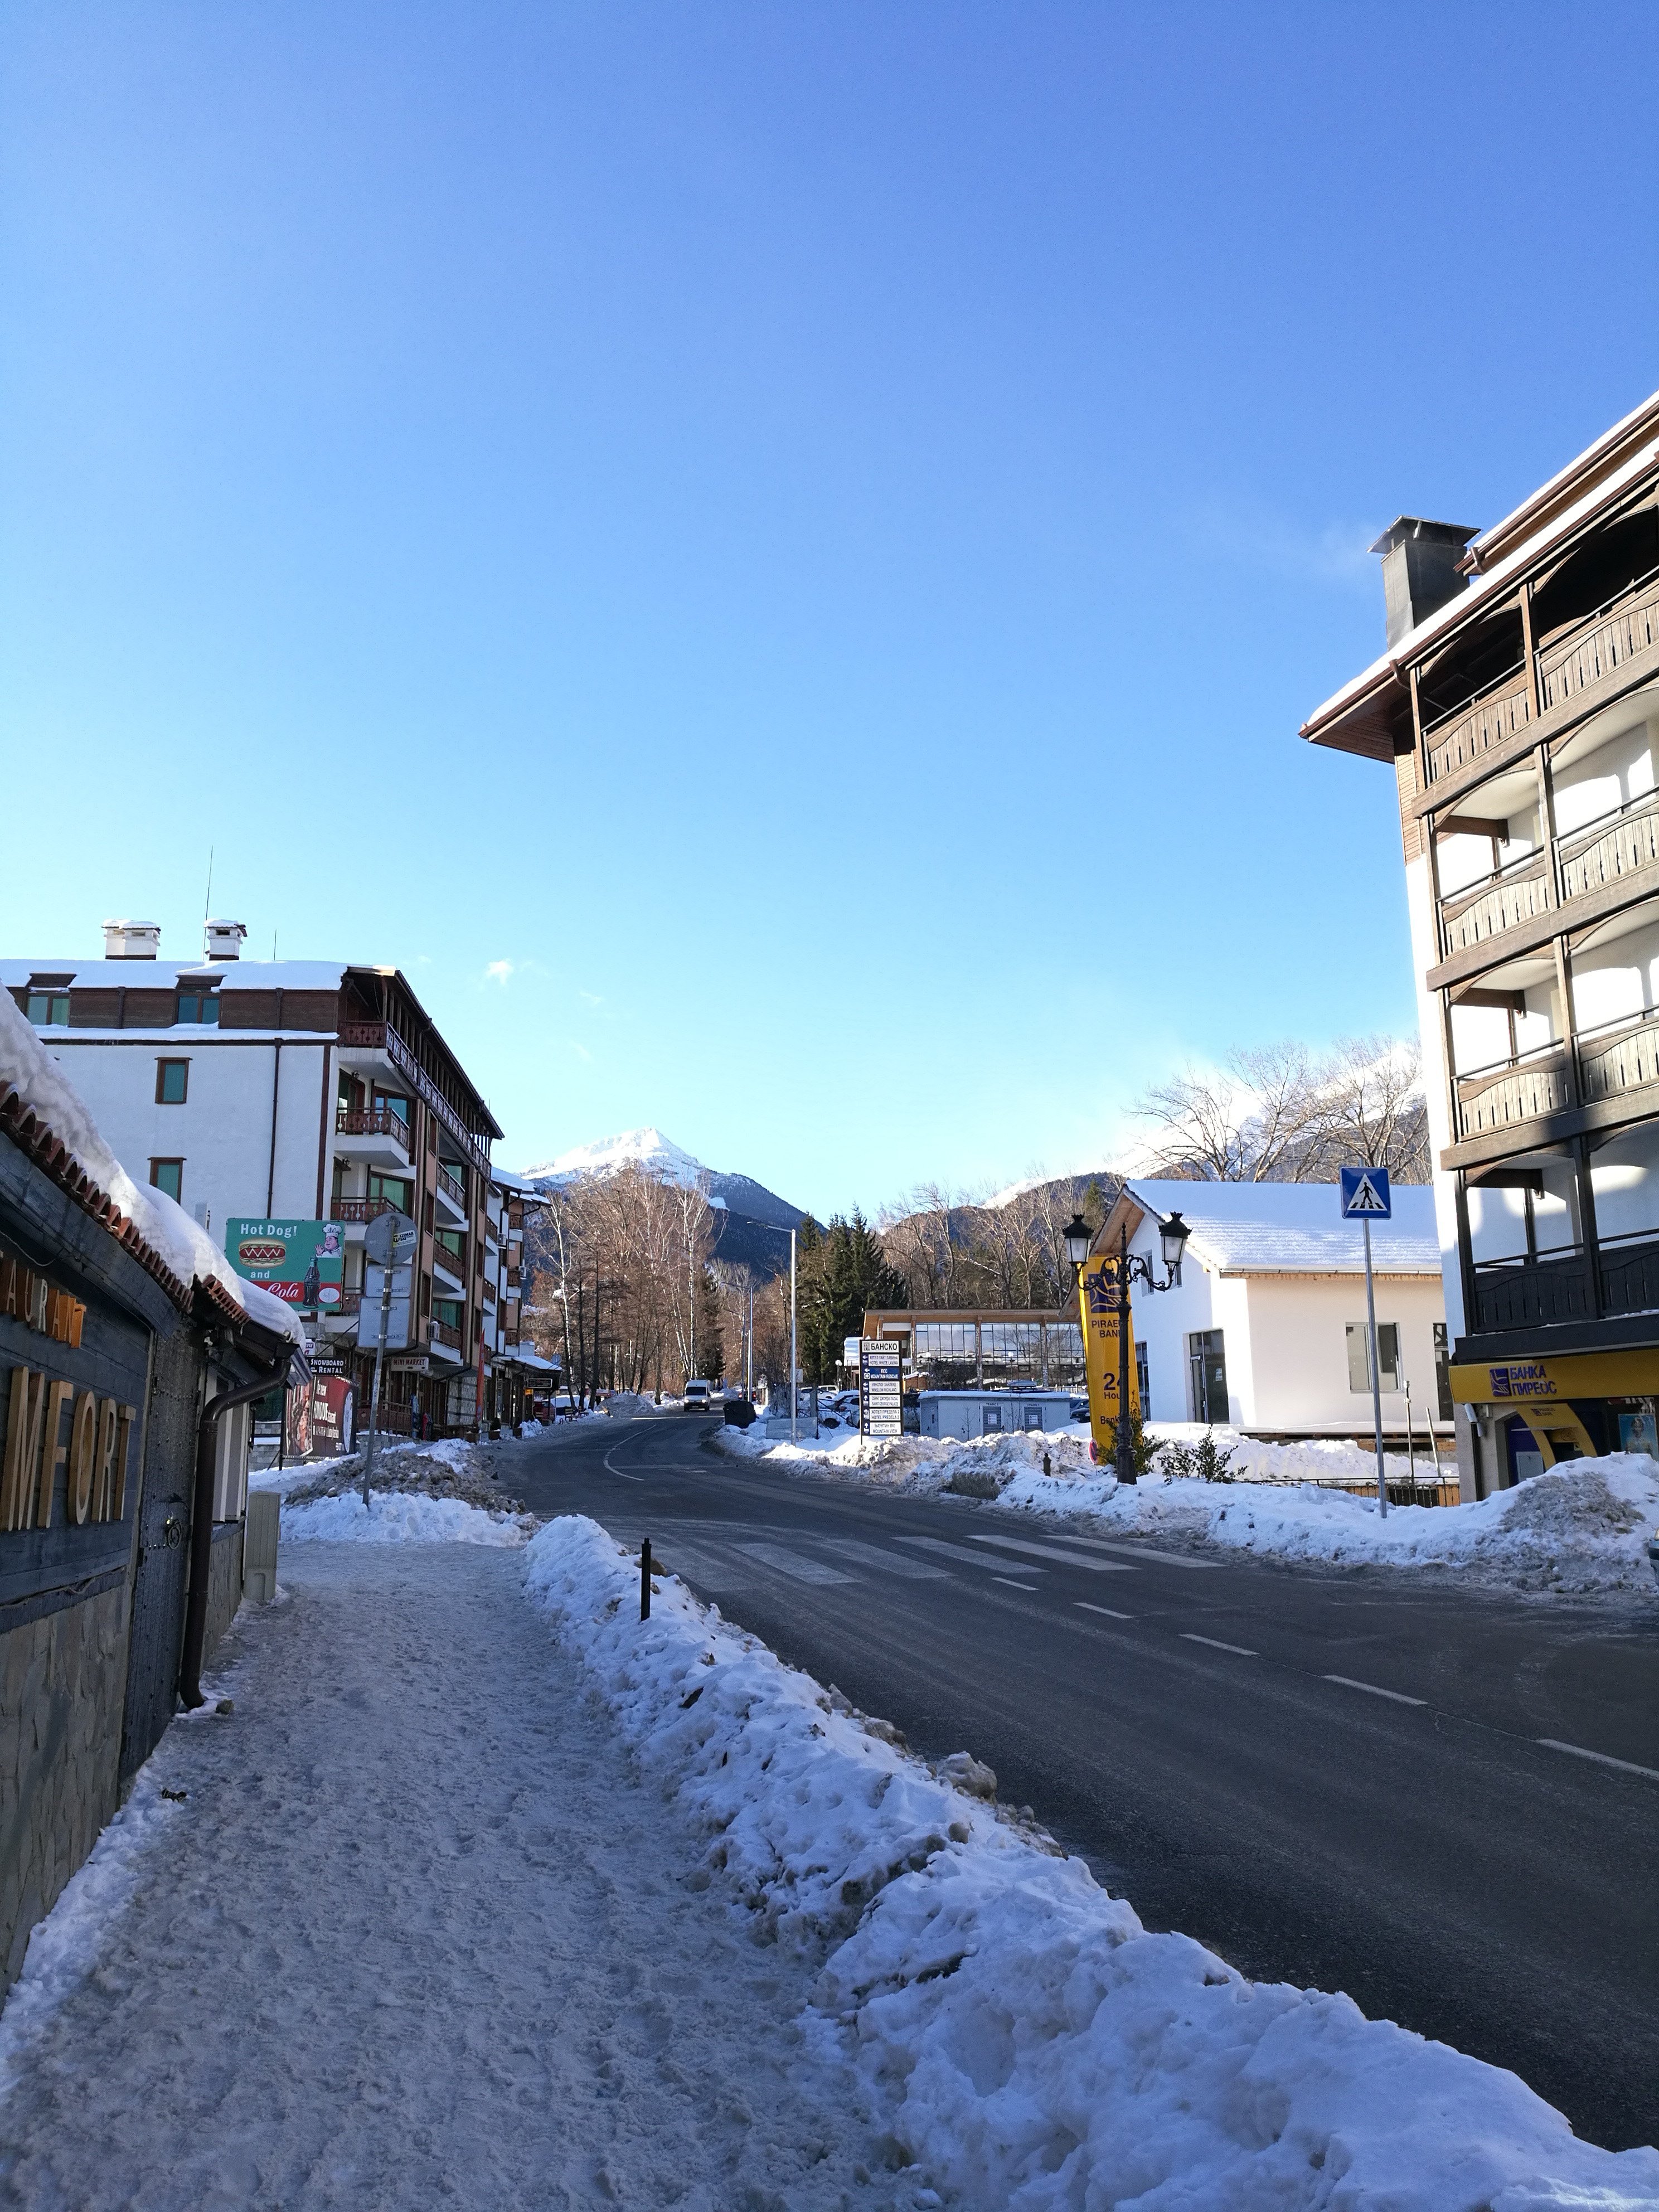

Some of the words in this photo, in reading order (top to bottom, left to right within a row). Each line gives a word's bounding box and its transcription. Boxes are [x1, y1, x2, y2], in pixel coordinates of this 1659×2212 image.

[241, 1224, 263, 1235] Hot
[267, 1225, 297, 1238] Dog!
[251, 1270, 270, 1279] and
[266, 1282, 299, 1298] Cola
[0, 1250, 86, 1348] AURANT
[1091, 1320, 1120, 1328] PIRAE
[1099, 1330, 1120, 1338] BAN
[1510, 1365, 1546, 1380] БАНКА
[1103, 1372, 1120, 1390] 2
[1511, 1381, 1557, 1395] ПИРЕОС
